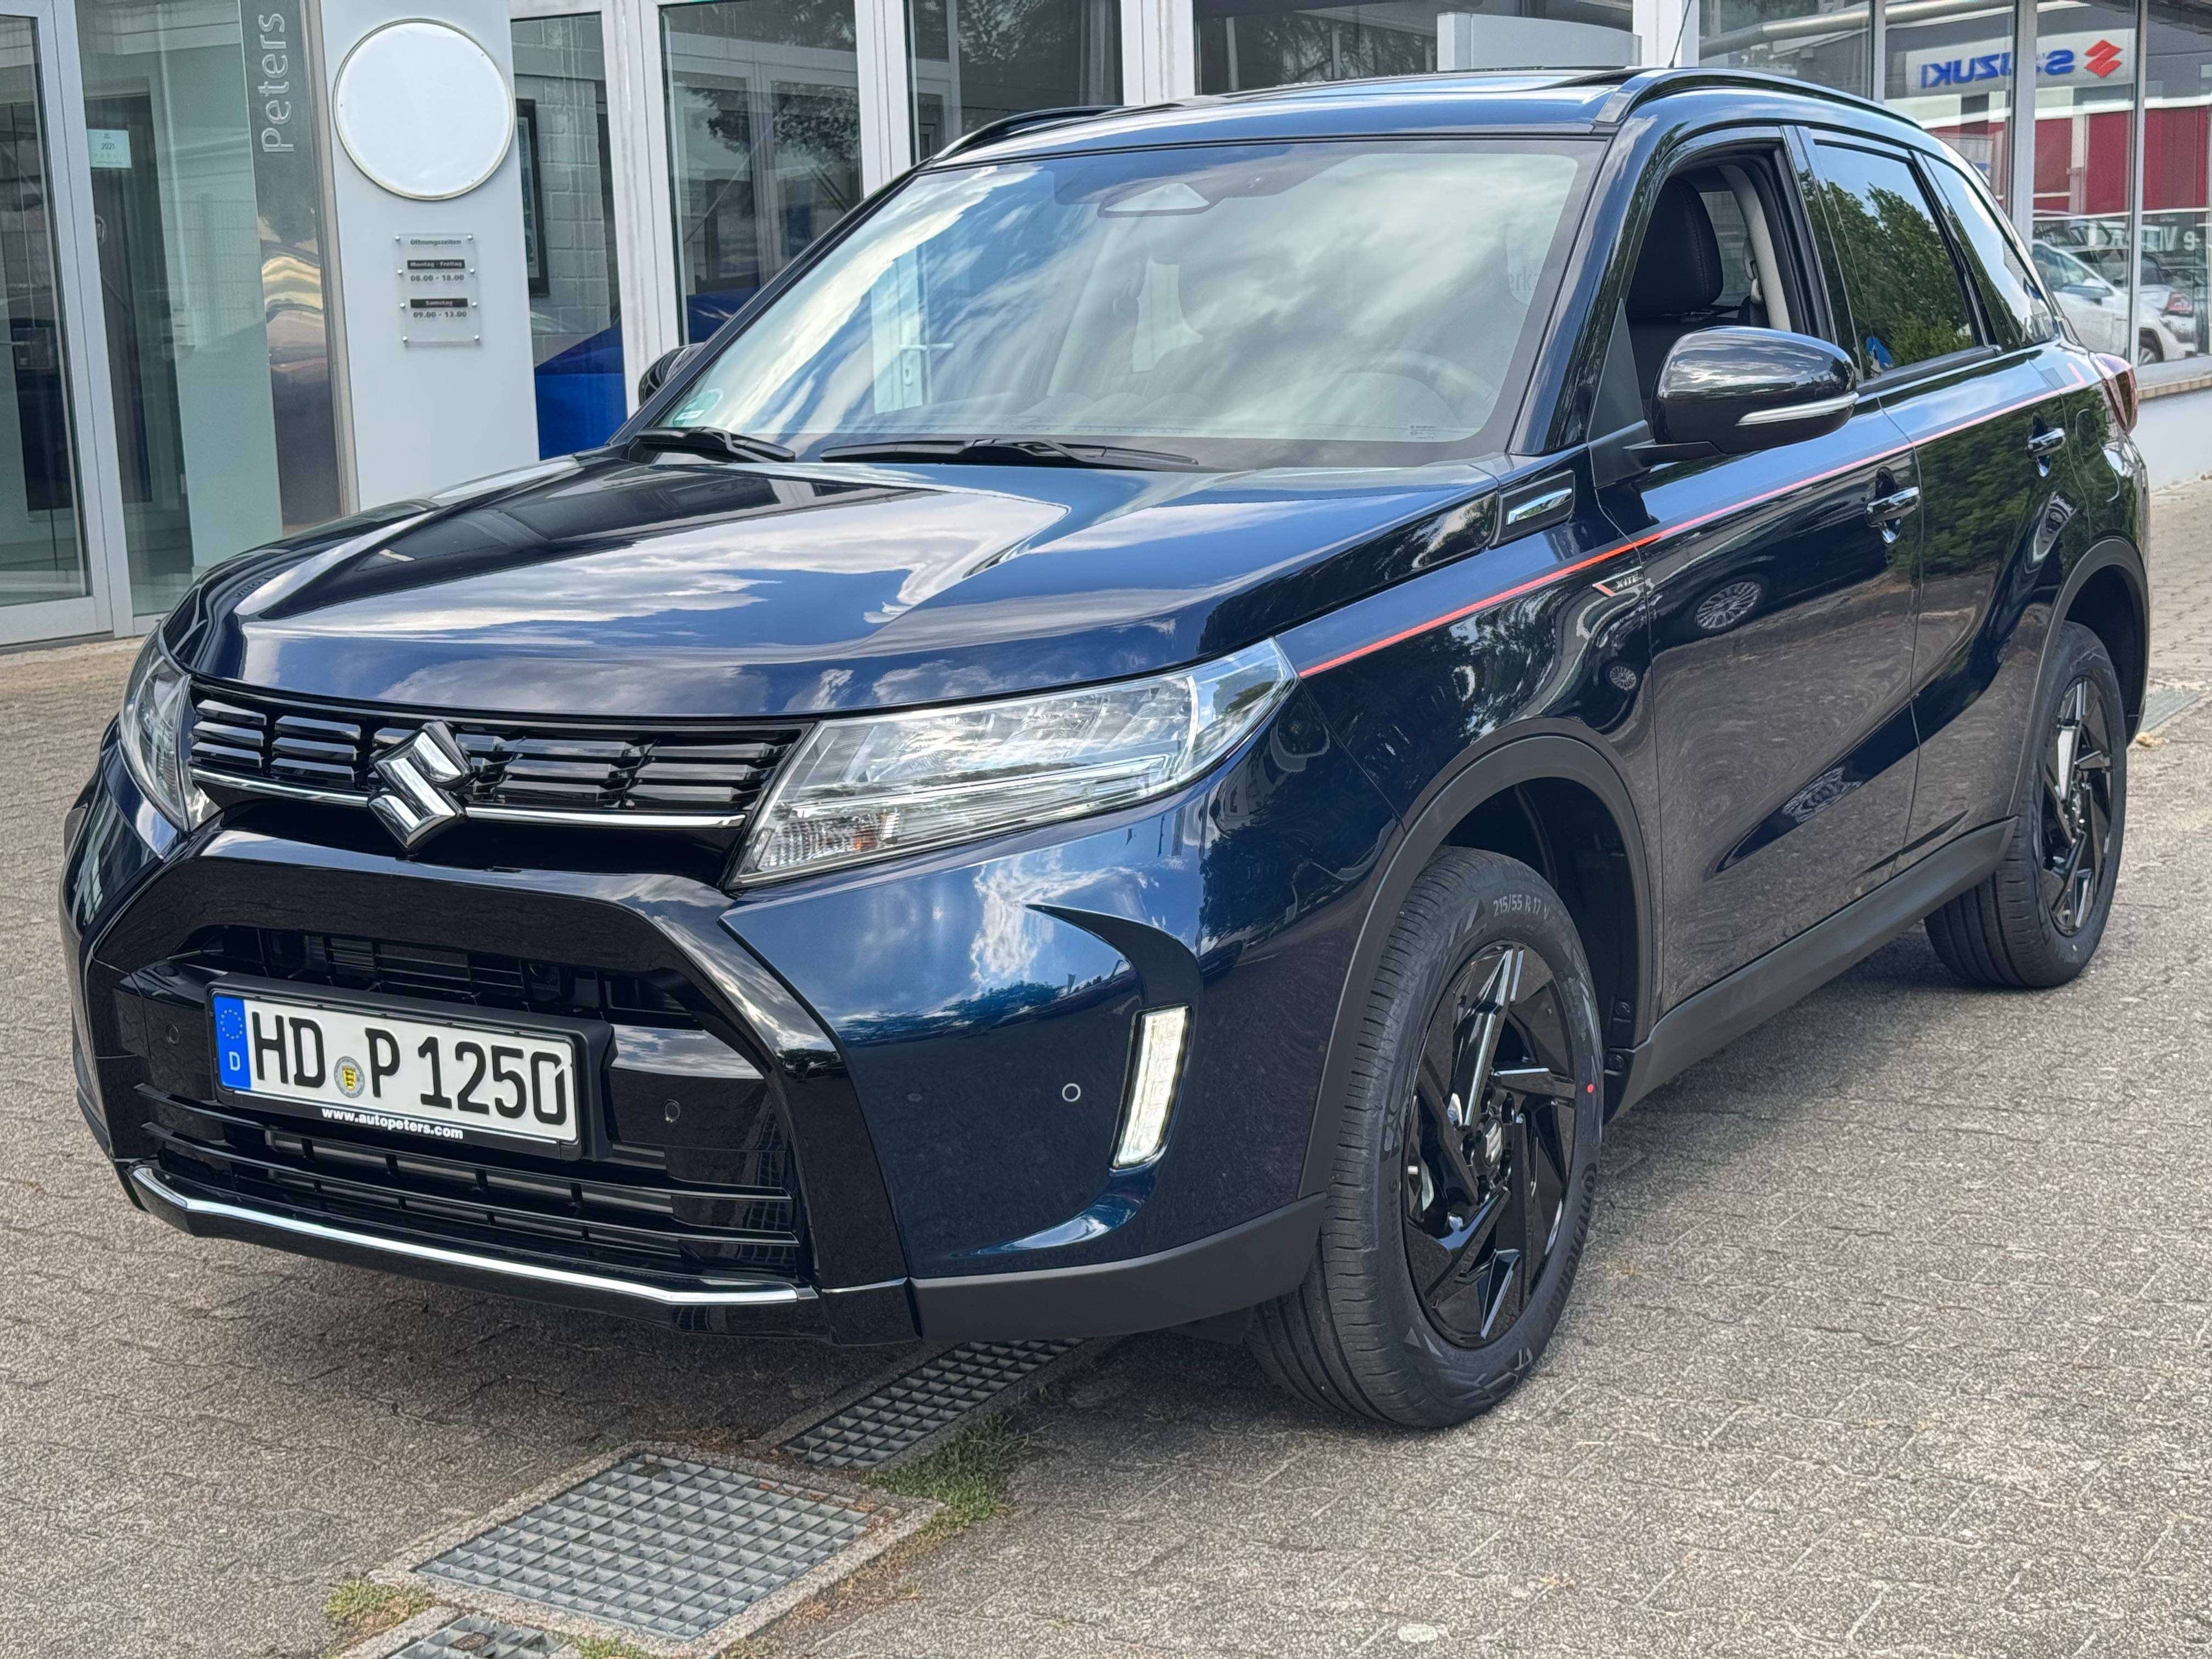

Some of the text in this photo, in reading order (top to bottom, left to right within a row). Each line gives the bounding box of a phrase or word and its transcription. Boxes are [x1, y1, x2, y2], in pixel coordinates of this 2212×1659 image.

[258, 14, 295, 153] Peters
[1493, 894, 1523, 918] 215/55
[1525, 895, 1532, 913] R
[1532, 897, 1542, 915] 17
[228, 1051, 241, 1071] D
[252, 1012, 326, 1088] HD
[364, 1027, 401, 1098] P
[418, 1036, 567, 1126] 1250
[321, 1107, 464, 1140] www.autopeters.com
